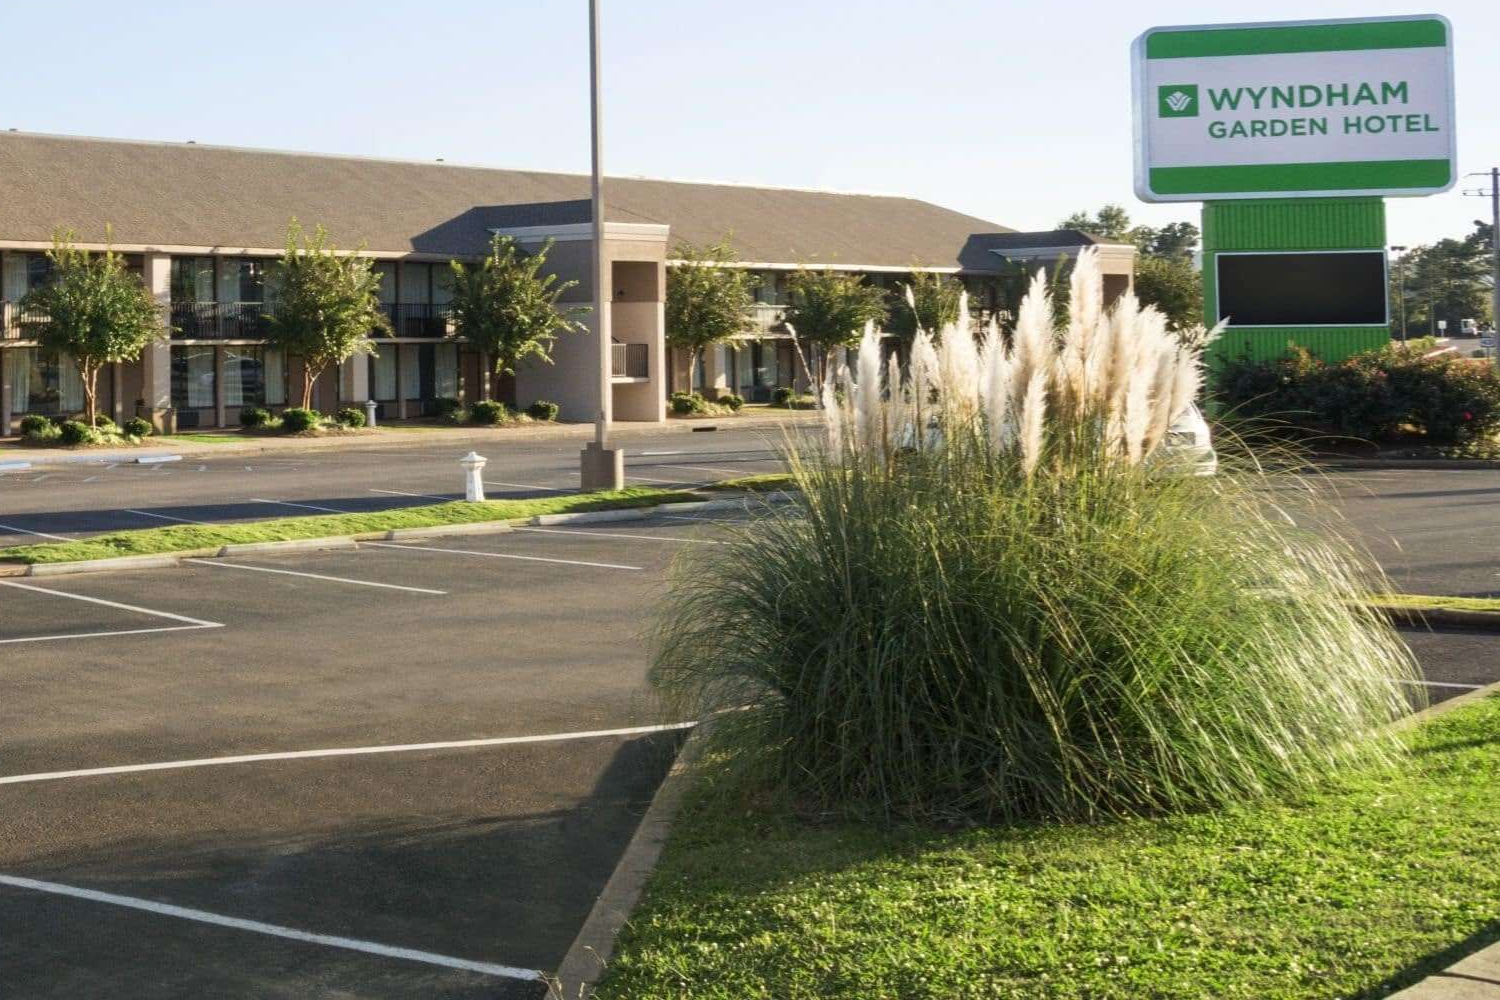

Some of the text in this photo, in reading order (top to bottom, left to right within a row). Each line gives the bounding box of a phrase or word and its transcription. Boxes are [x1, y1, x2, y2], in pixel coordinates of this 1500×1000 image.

[1207, 80, 1409, 112] WYNDHAM
[1207, 113, 1440, 140] GARDEN HOTEL
